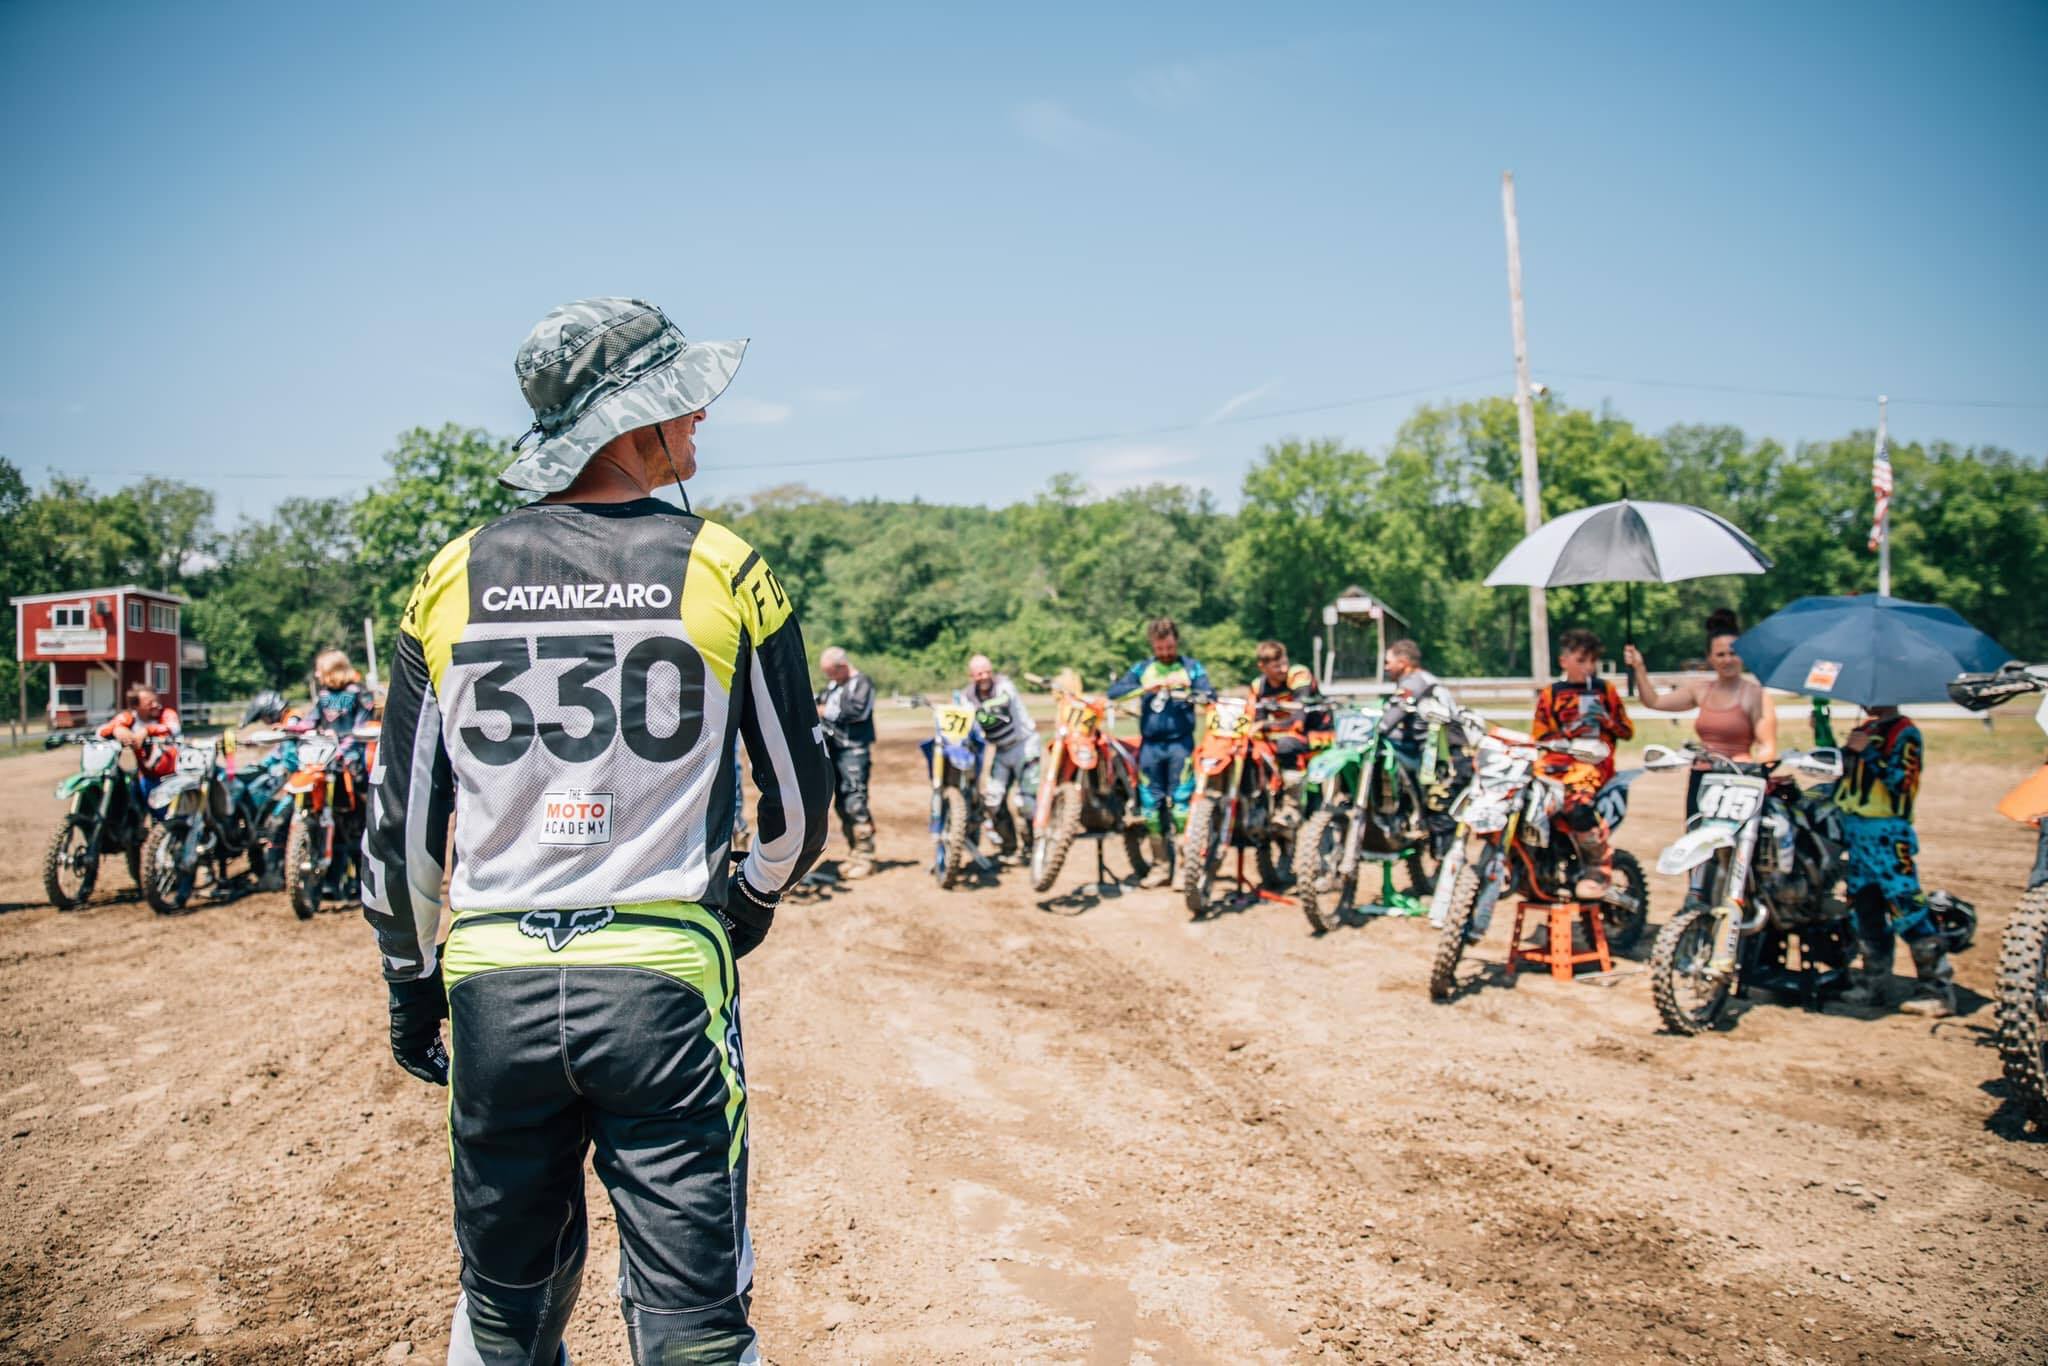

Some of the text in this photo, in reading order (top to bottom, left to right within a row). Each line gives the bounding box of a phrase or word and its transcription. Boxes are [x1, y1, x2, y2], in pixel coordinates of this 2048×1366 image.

[482, 583, 672, 611] CATANZARO
[451, 634, 705, 766] 330
[568, 788, 582, 800] THE
[547, 803, 605, 819] MOTO
[545, 820, 605, 835] ACADEMY
